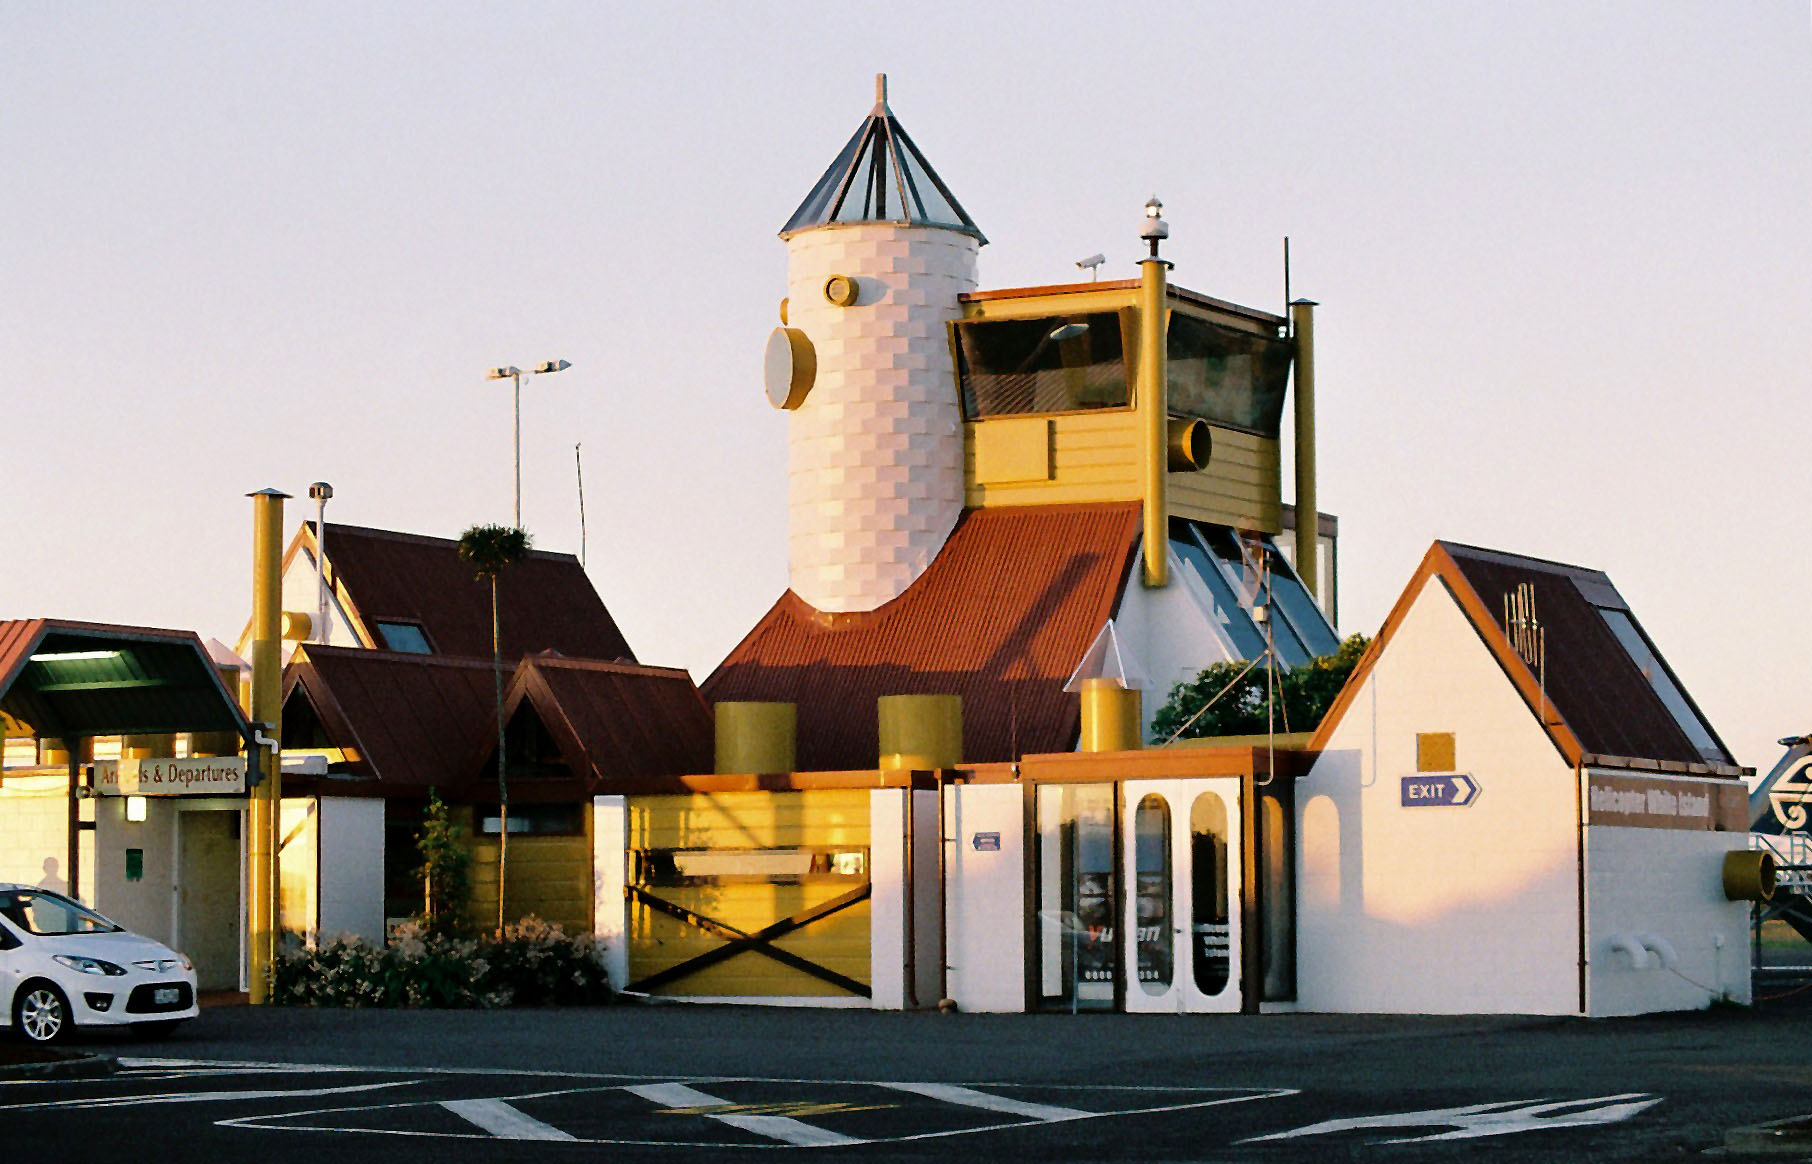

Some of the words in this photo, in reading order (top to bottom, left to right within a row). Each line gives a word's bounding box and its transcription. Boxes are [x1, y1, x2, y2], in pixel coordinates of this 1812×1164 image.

[153, 764, 163, 784] &
[168, 763, 239, 788] Departures
[1408, 783, 1446, 799] EXIT
